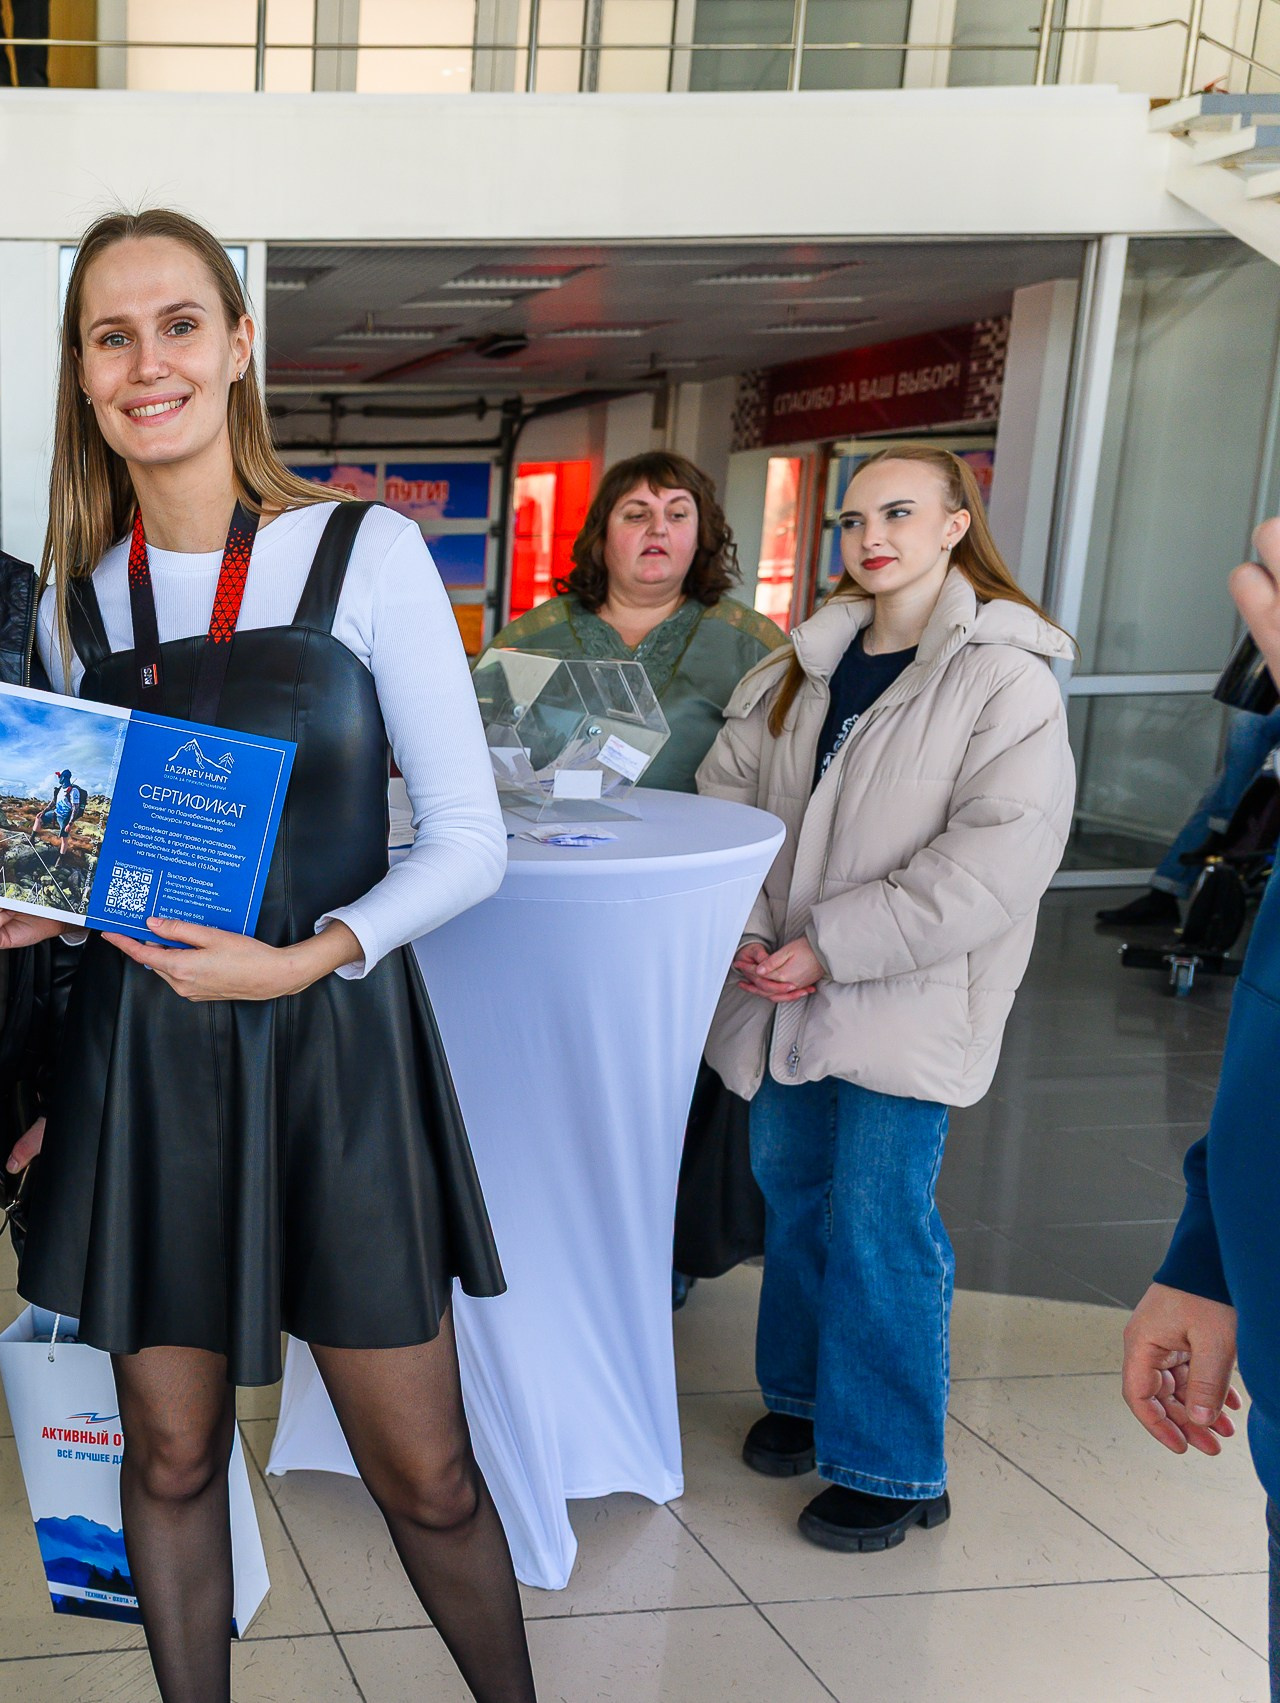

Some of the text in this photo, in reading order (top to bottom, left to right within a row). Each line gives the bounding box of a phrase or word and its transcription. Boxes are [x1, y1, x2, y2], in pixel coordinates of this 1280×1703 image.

[774, 361, 961, 416] СПАСИБО ЗА ВАШ ВЫБОР!
[386, 481, 449, 501] ПУТИ!
[164, 764, 228, 783] LAZAREV HUNT
[139, 784, 246, 818] СЕРТИФИКАТ
[133, 822, 168, 835] Сертификат
[182, 834, 202, 842] право
[171, 840, 207, 852] программе
[187, 876, 213, 887] Лазарев
[42, 1426, 124, 1446] АКТИВНЫЙ О
[57, 1449, 73, 1459] ВСЁ
[75, 1451, 110, 1462] ЛУЧШЕЕ
